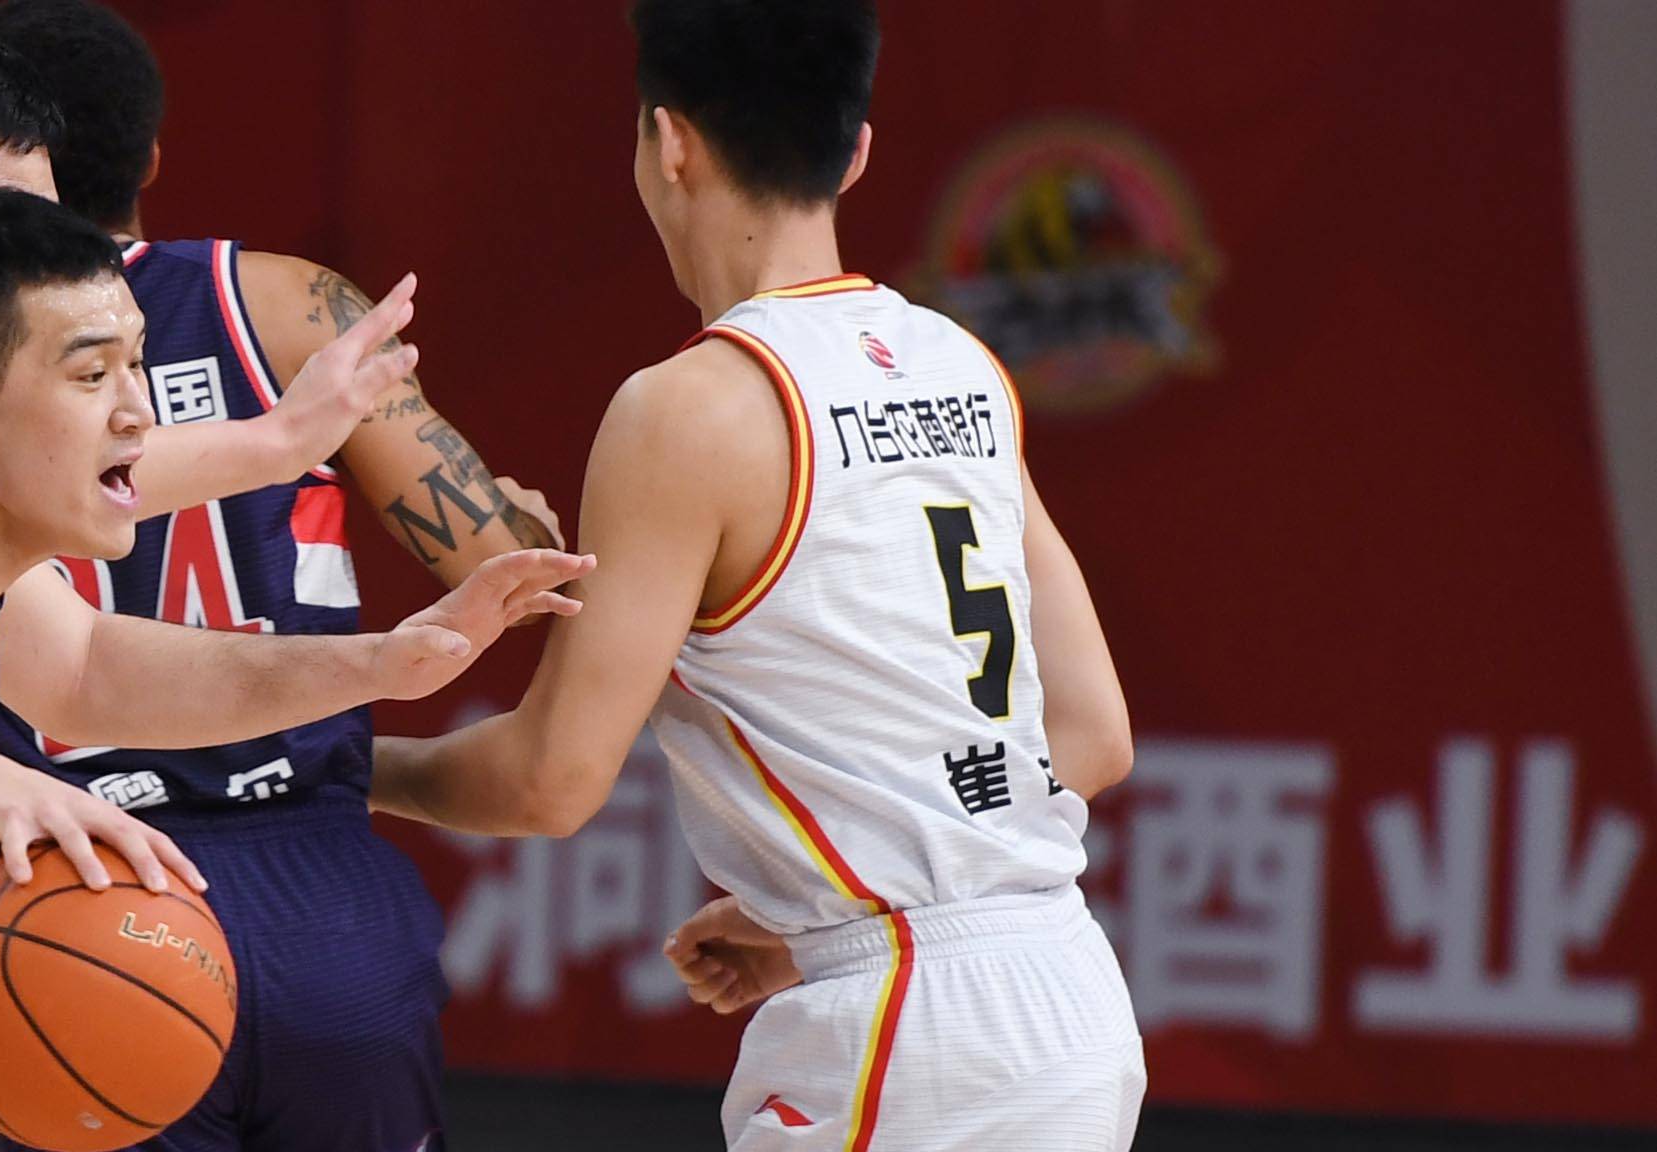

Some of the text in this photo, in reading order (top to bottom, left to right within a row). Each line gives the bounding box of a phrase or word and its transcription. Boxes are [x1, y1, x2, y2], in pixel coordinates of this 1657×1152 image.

[149, 356, 229, 426] 国
[828, 392, 997, 469] 九台农商银行
[923, 502, 1016, 722] 5
